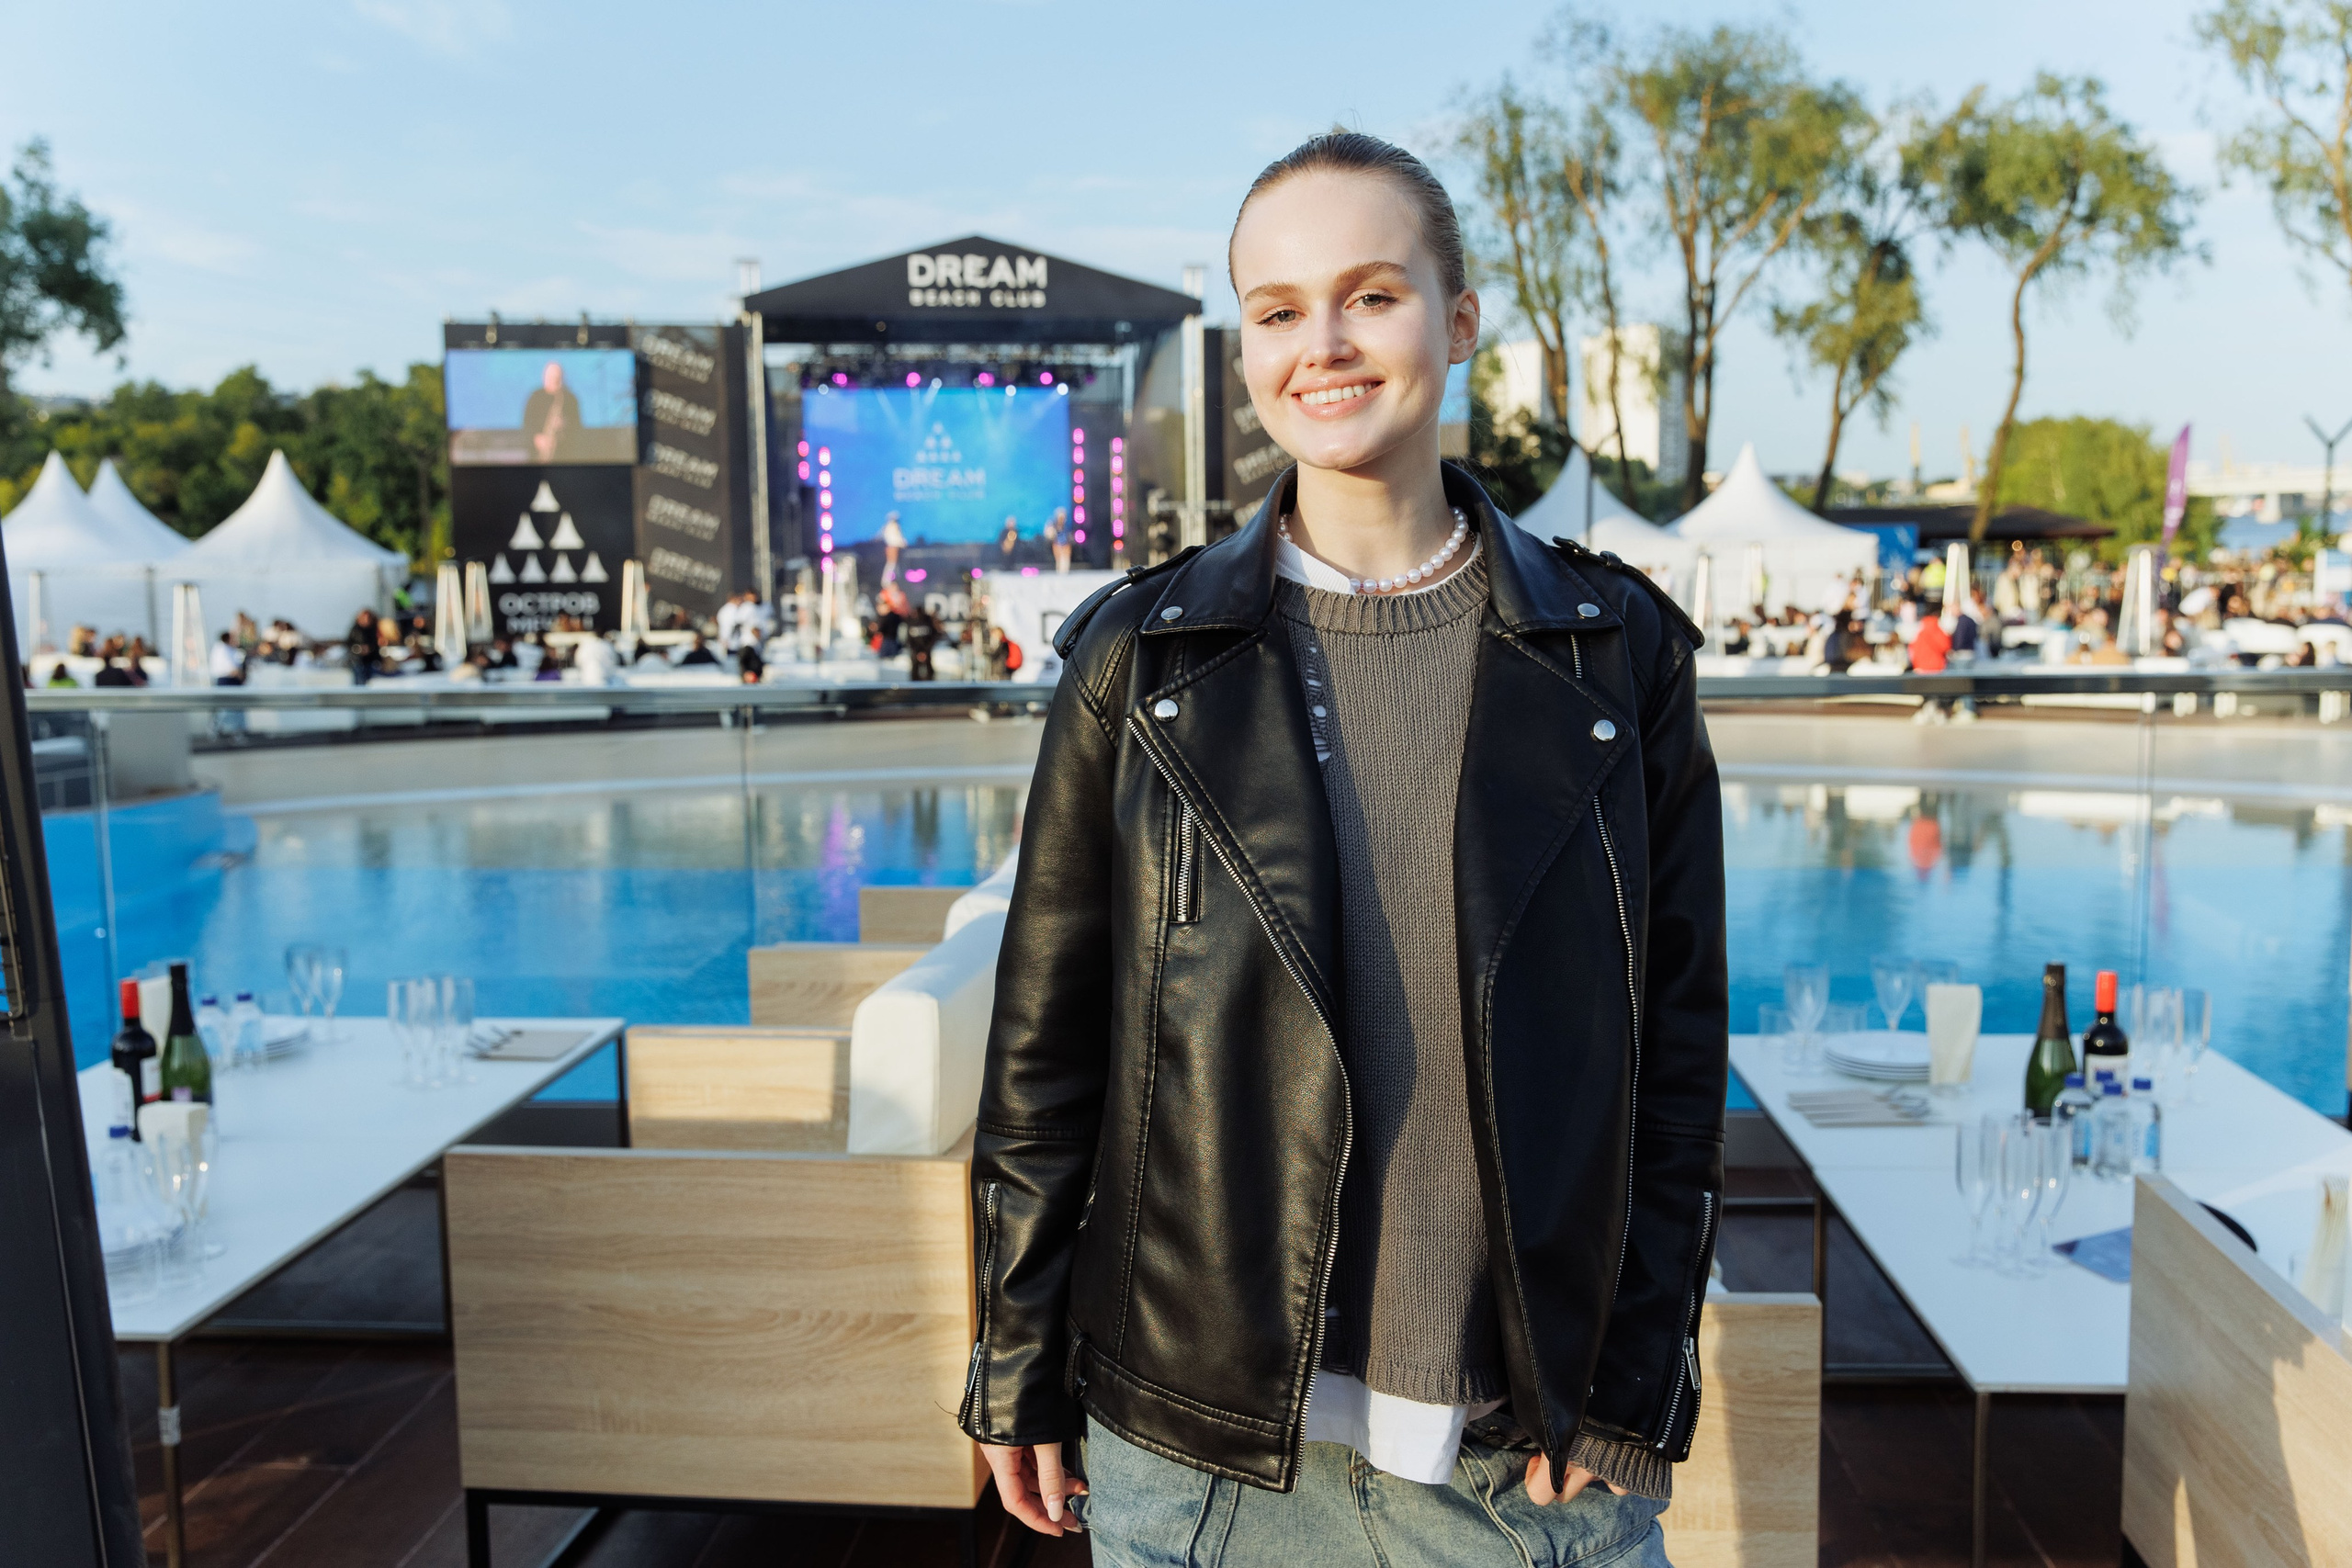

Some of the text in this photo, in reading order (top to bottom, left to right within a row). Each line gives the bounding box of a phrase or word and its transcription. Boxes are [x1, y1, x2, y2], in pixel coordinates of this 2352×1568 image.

[907, 254, 1047, 288] DREAM
[909, 288, 1046, 308] BEACH CLUB
[893, 467, 986, 489] DREAM
[498, 592, 600, 616] ОСТРОВ
